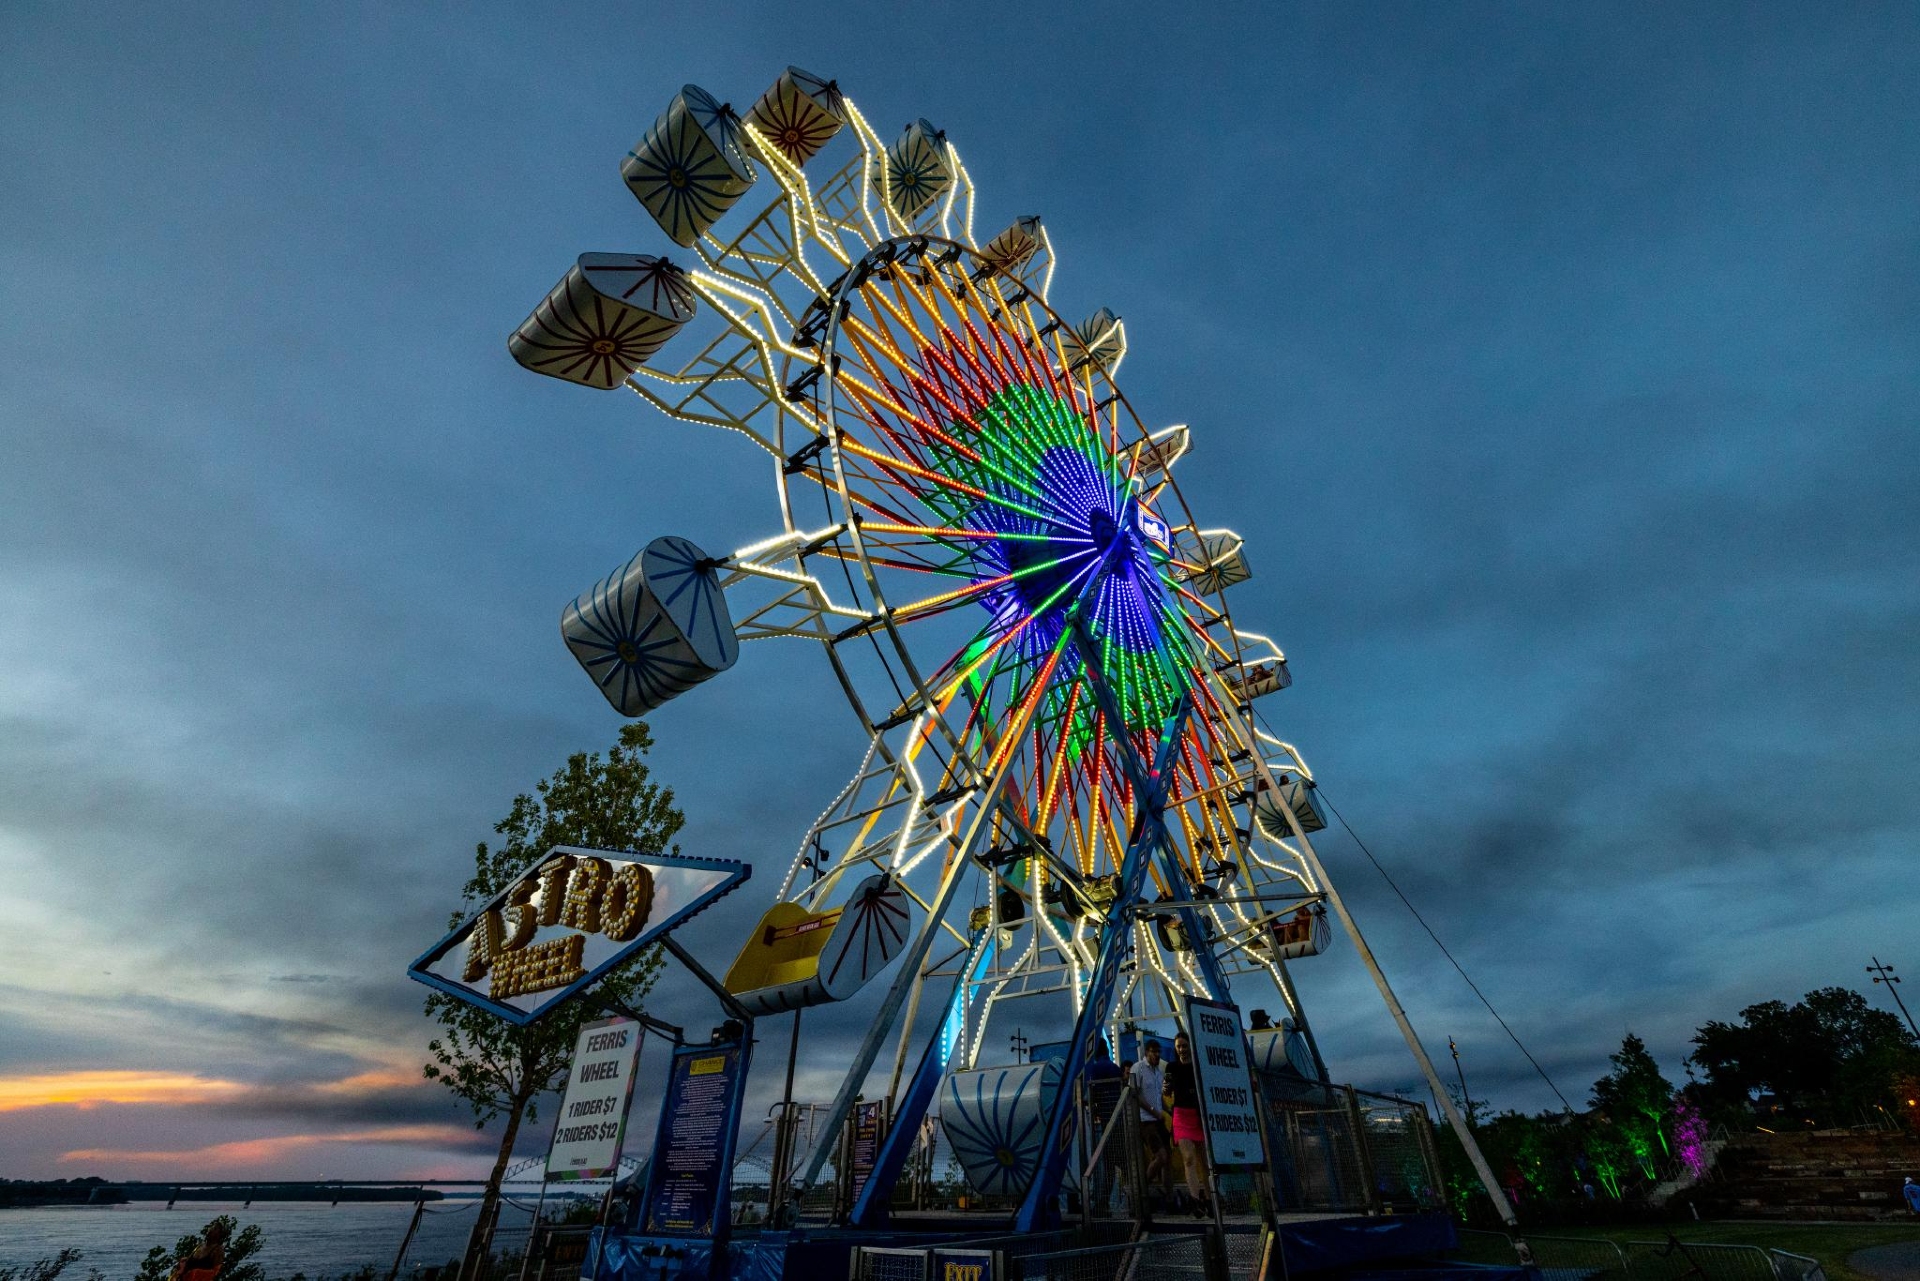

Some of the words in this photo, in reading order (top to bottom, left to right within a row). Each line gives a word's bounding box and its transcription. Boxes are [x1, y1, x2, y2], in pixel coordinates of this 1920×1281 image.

[462, 855, 654, 982] ASTRO
[1200, 1012, 1235, 1037] FERRIS
[586, 1029, 629, 1053] FERRIS
[1205, 1045, 1240, 1068] WHEEL
[579, 1060, 620, 1083] WHEEL
[569, 1102, 575, 1118] 1
[574, 1098, 604, 1117] RIDER
[603, 1095, 618, 1115] $7
[1210, 1087, 1215, 1103] 1
[1215, 1087, 1238, 1105] RIDER
[1238, 1087, 1248, 1107] $7
[868, 1106, 876, 1118] 4
[555, 1128, 565, 1144] 2
[564, 1123, 599, 1143] RIDERS
[599, 1121, 619, 1142] $12
[1209, 1115, 1216, 1131] 2
[1215, 1114, 1245, 1133] RIDERS
[1244, 1114, 1258, 1135] $12
[944, 1262, 983, 1281] EXIT
